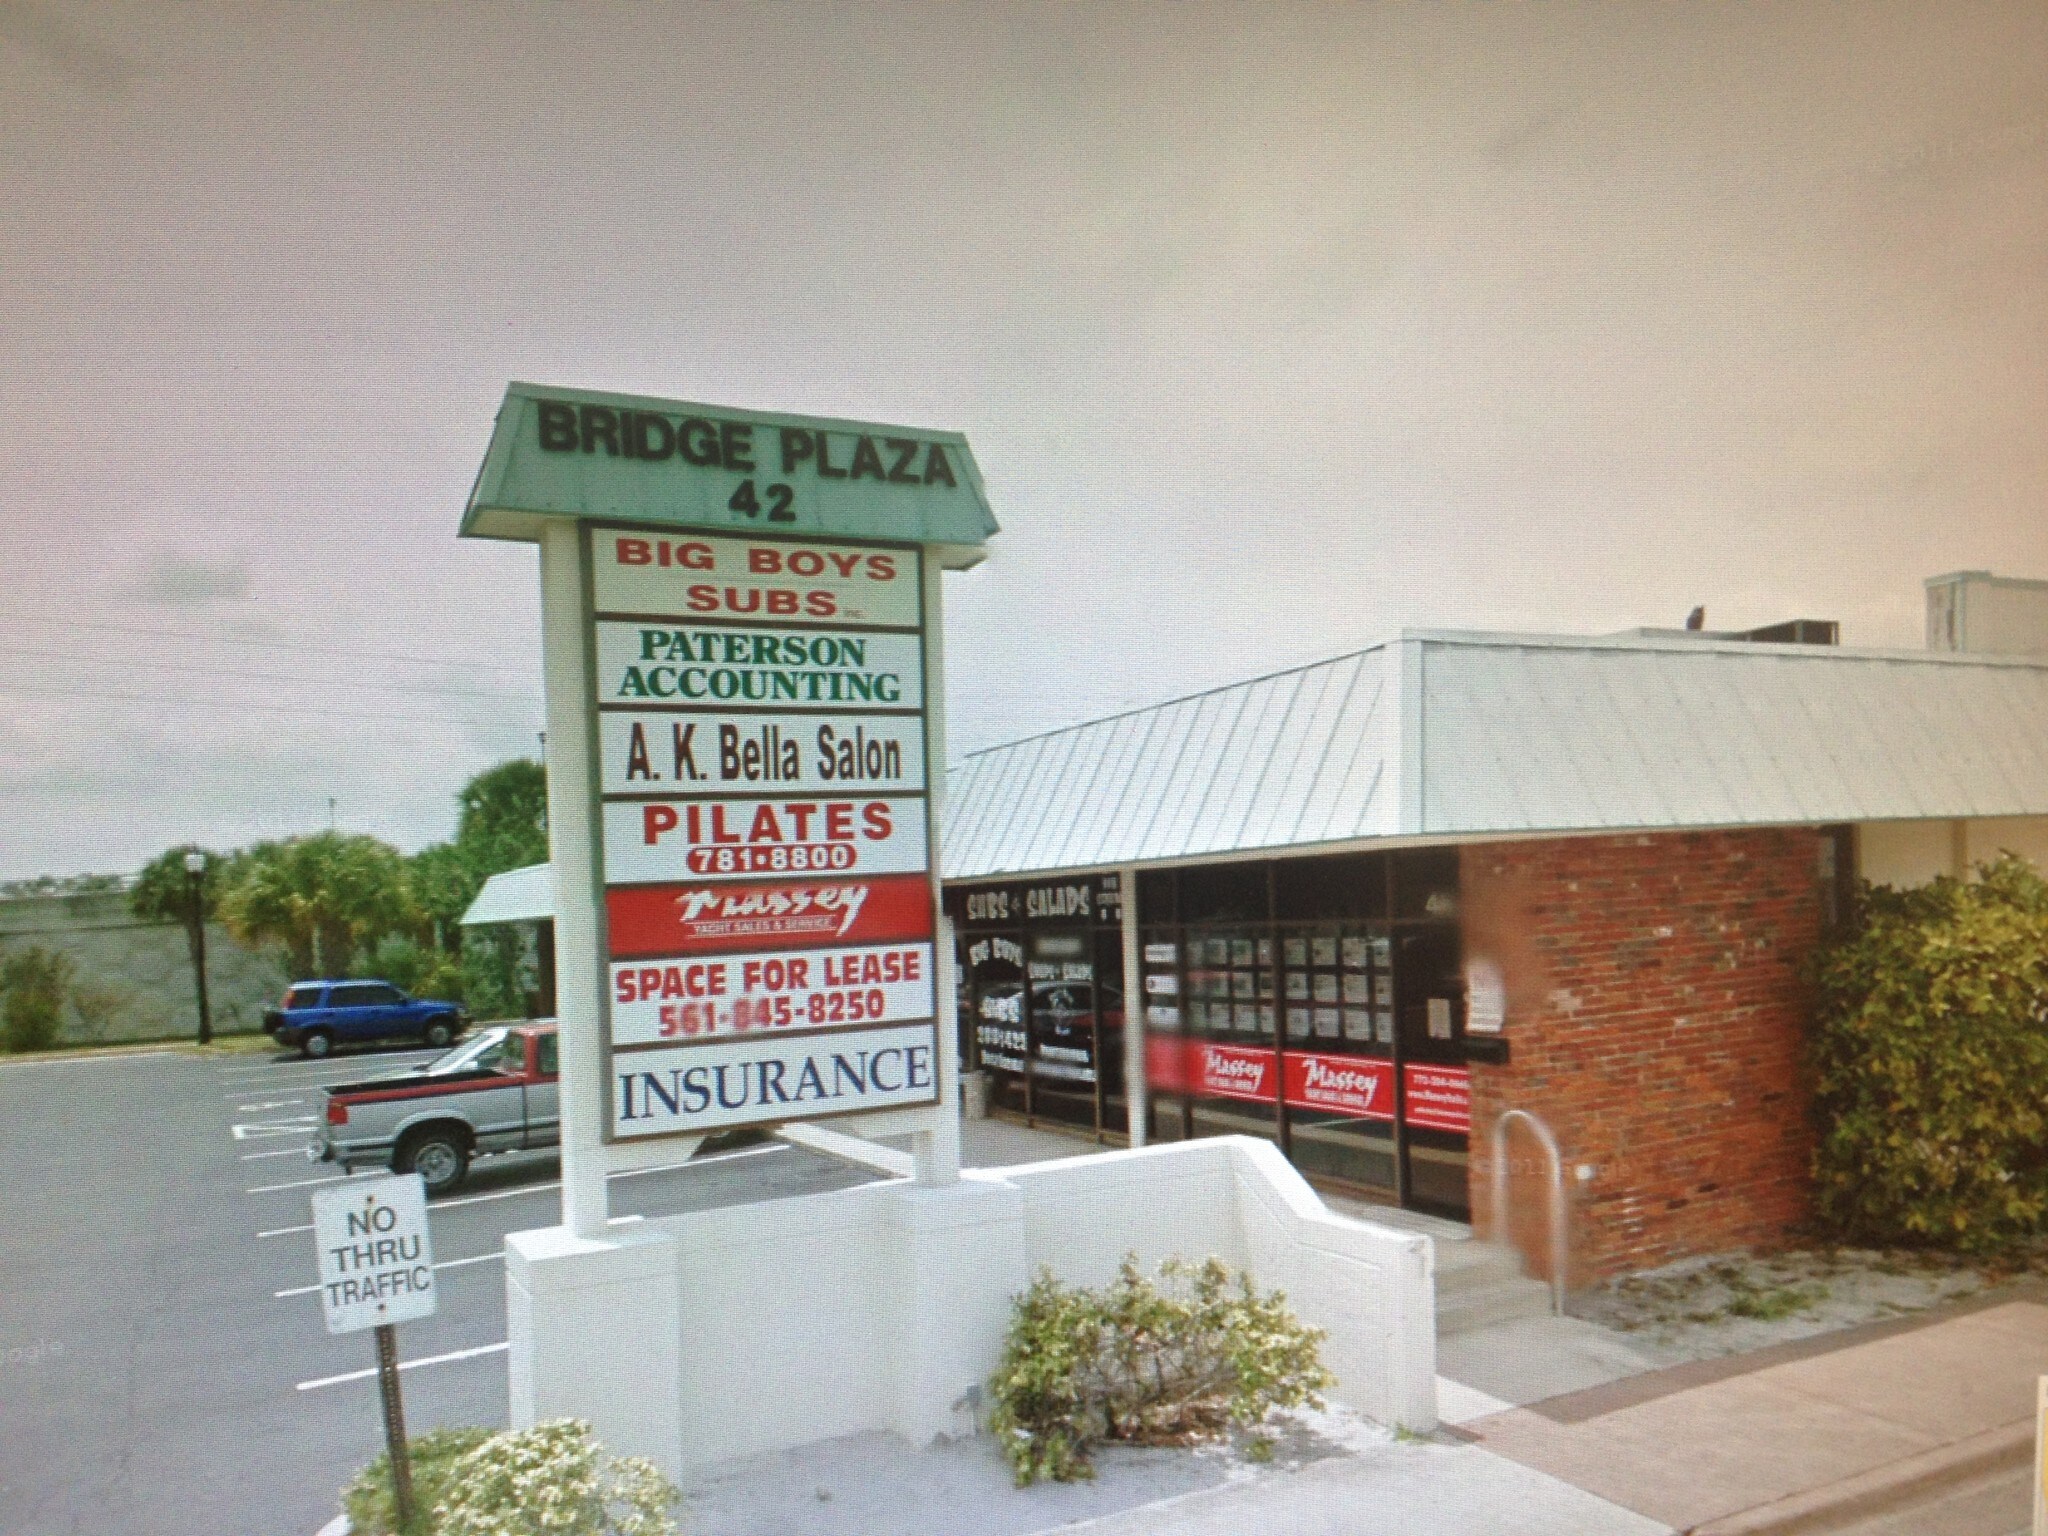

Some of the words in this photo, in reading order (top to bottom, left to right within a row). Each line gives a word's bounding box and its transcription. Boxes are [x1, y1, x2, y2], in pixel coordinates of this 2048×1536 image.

[537, 402, 755, 472] BRIDGE
[781, 426, 957, 487] PLAZA
[728, 479, 797, 522] 42
[616, 538, 715, 570] BIG
[749, 548, 896, 580] BOYS
[686, 584, 837, 616] SUBS
[639, 630, 866, 666] PATERSON
[618, 666, 900, 702] ACCOUNTING
[626, 722, 660, 780] A.
[674, 723, 707, 780] K.
[720, 723, 799, 780] Bella
[818, 724, 900, 780] Salon
[643, 802, 893, 845] PILATES
[616, 963, 727, 1003] SPACE
[743, 957, 808, 993] FOR
[824, 951, 920, 986] LEASE
[619, 1046, 932, 1121] INSURANCE
[348, 1206, 396, 1237] NO
[330, 1234, 420, 1272] THRU
[326, 1265, 430, 1307] TRAFFIC
